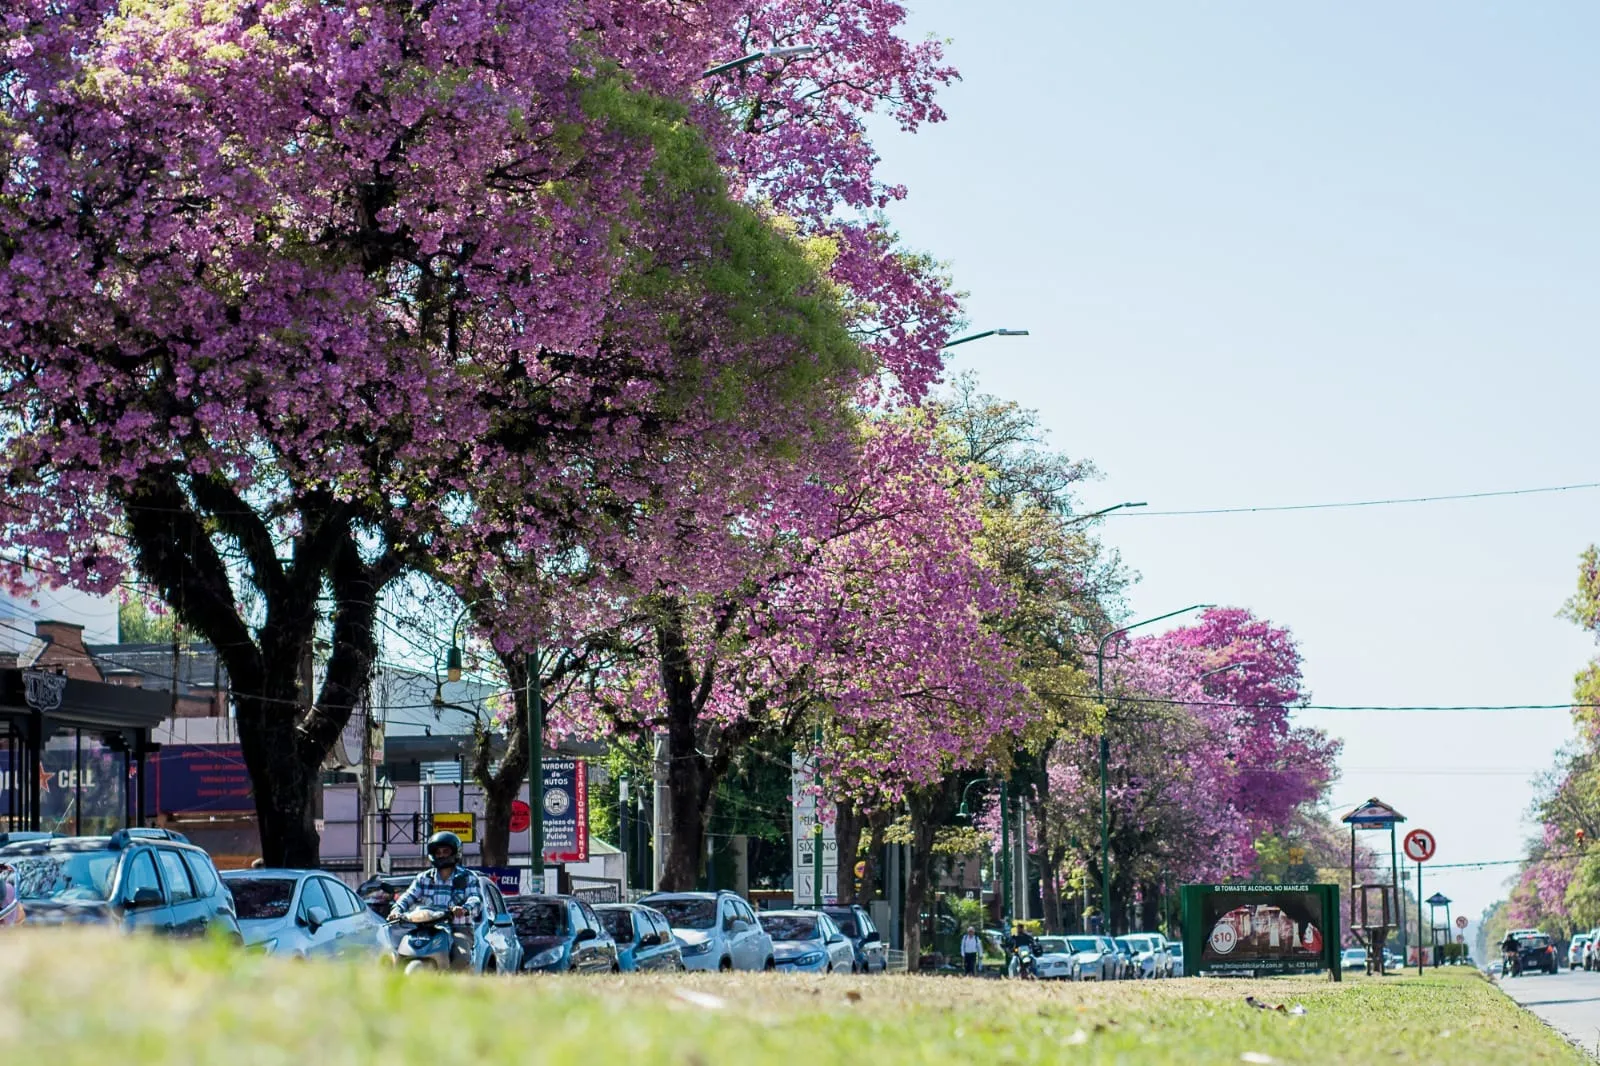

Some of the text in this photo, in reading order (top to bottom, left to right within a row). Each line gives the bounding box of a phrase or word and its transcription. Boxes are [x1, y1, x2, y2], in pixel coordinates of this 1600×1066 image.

[541, 762, 574, 770] AVADERO
[58, 769, 96, 788] CELL
[577, 761, 585, 860] ESTACIONAMIENTO
[501, 876, 519, 885] CELL
[1213, 932, 1232, 944] $10
